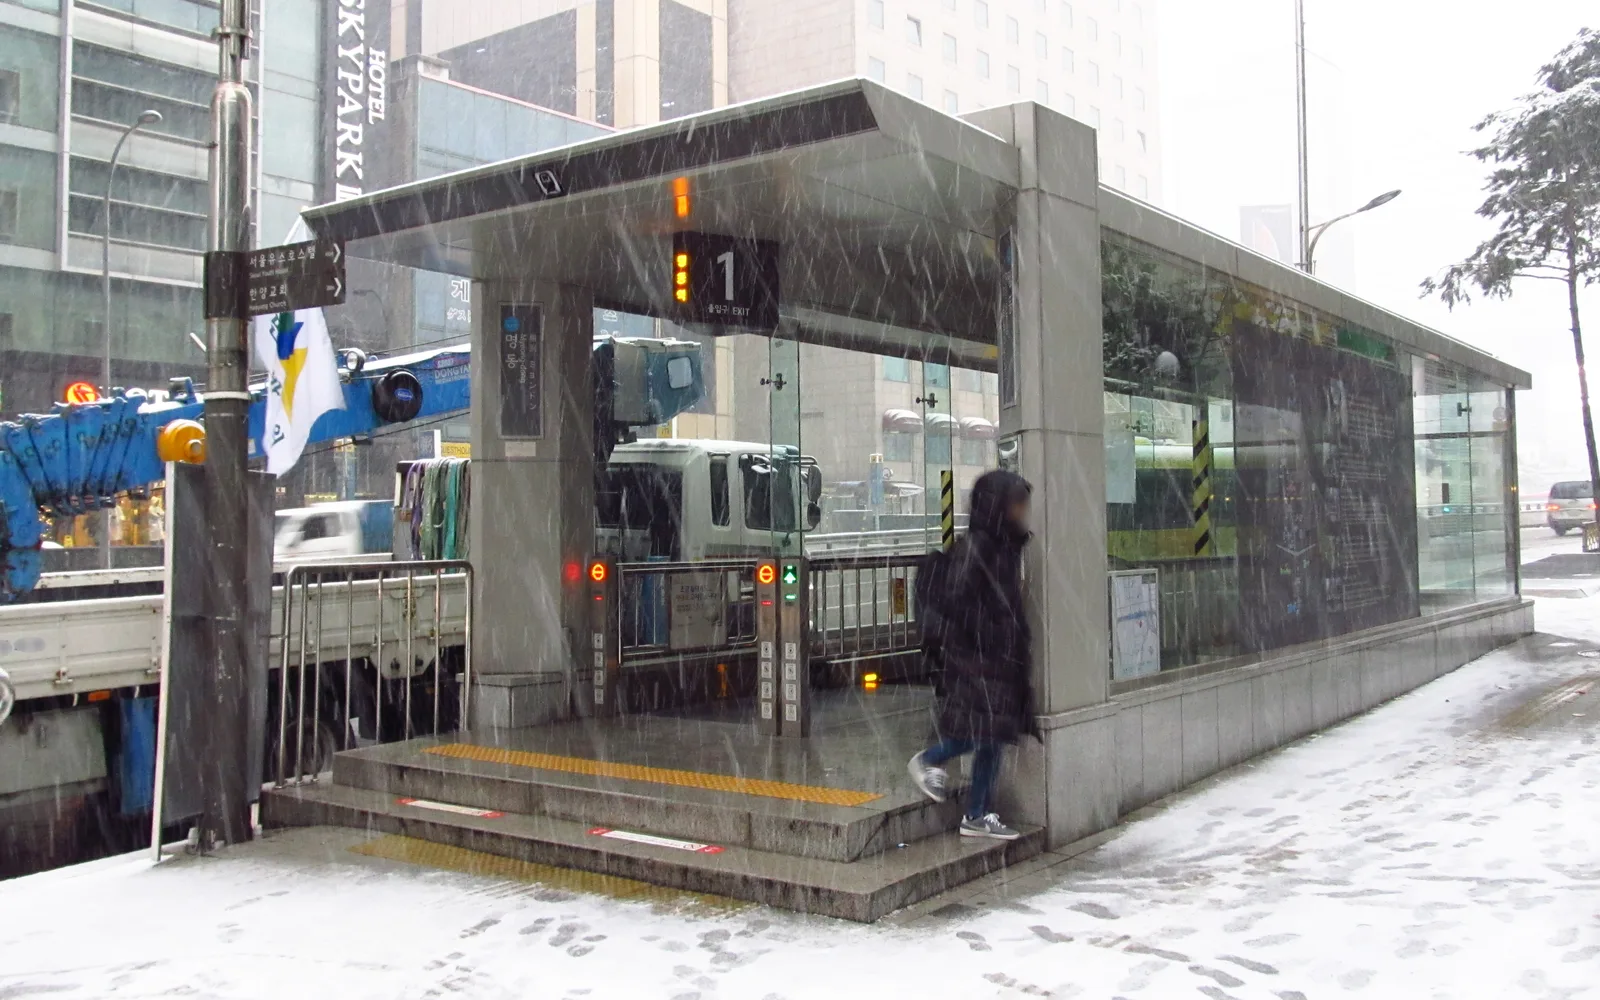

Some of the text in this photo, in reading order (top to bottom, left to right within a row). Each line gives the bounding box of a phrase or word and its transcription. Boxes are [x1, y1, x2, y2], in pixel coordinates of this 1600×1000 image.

[368, 47, 386, 124] HOTEL
[249, 245, 316, 268] 서울유스호스텔
[717, 251, 734, 301] 1
[249, 284, 288, 301] 한양교회
[708, 304, 750, 317] 출입구 EXIT
[505, 333, 518, 369] 명동
[434, 363, 471, 379] DONGYA
